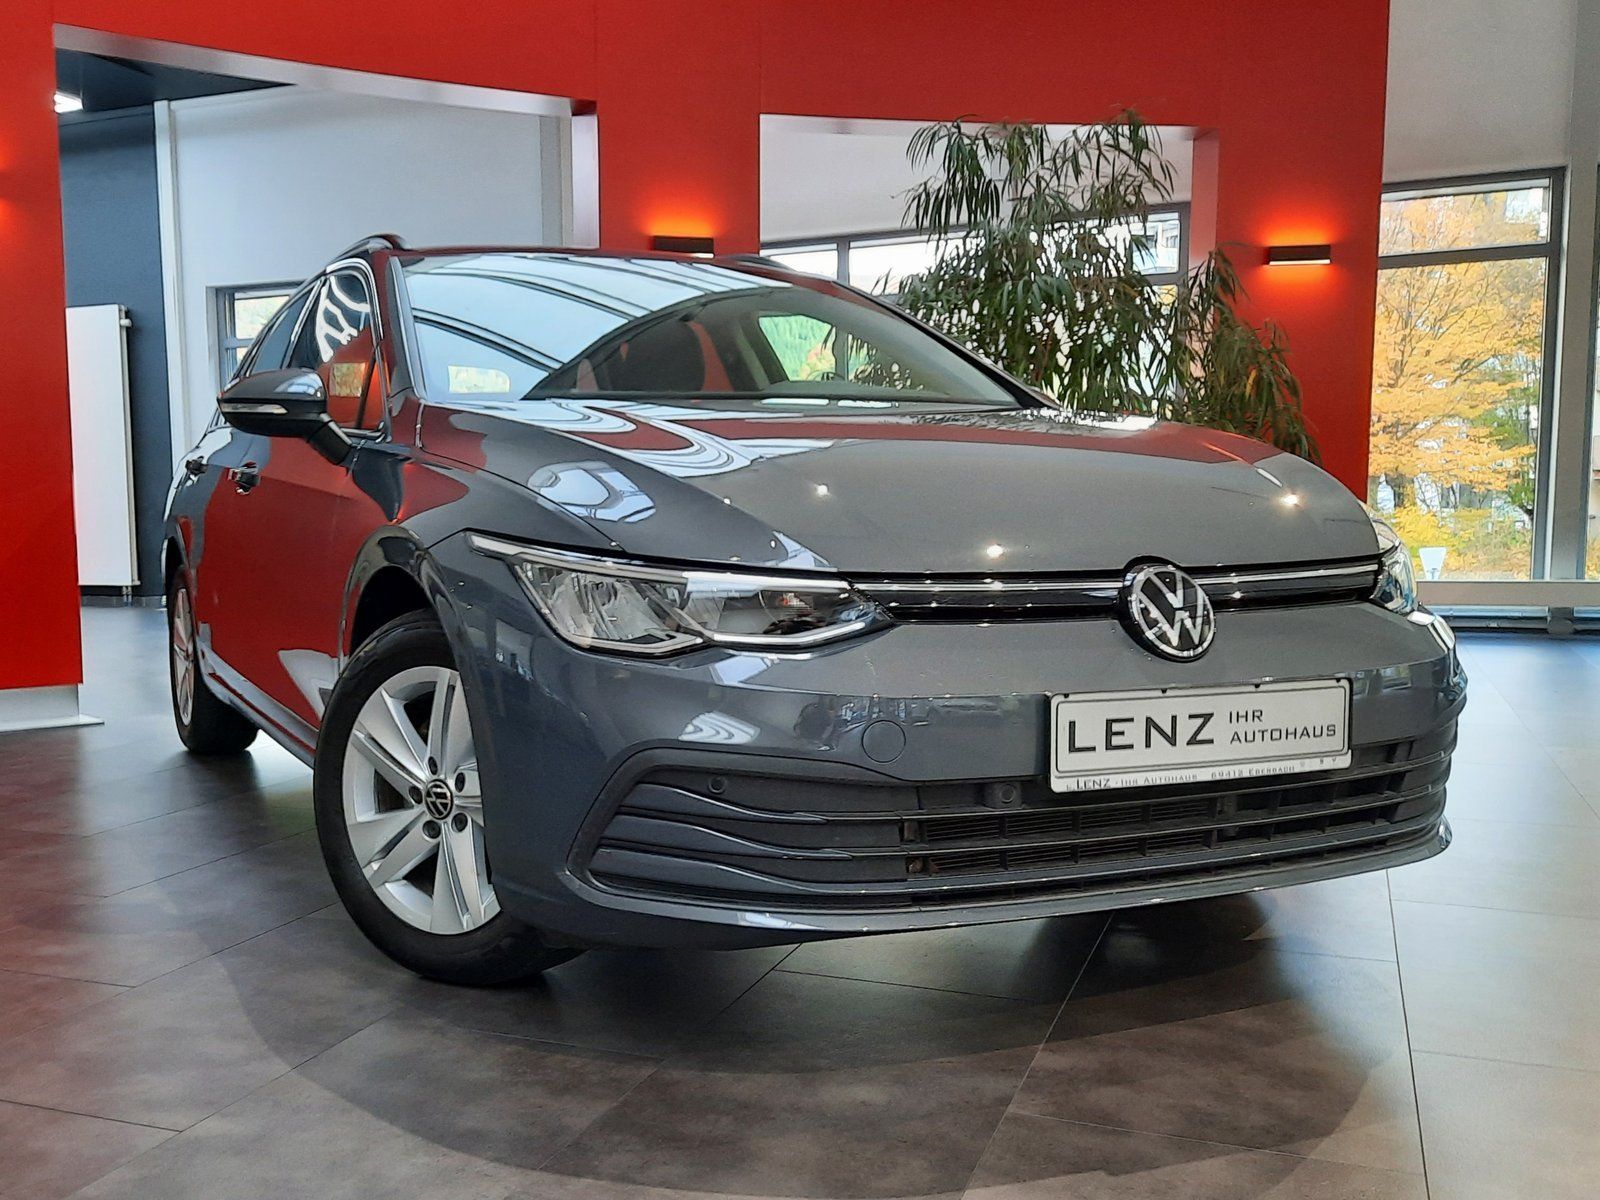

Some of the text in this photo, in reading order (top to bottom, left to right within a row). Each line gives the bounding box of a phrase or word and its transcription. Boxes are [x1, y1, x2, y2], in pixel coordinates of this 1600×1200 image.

[1229, 709, 1264, 724] IHR
[1068, 712, 1215, 753] LENZ
[1230, 724, 1336, 745] AUTOHAUS
[1076, 778, 1111, 790] LENZ
